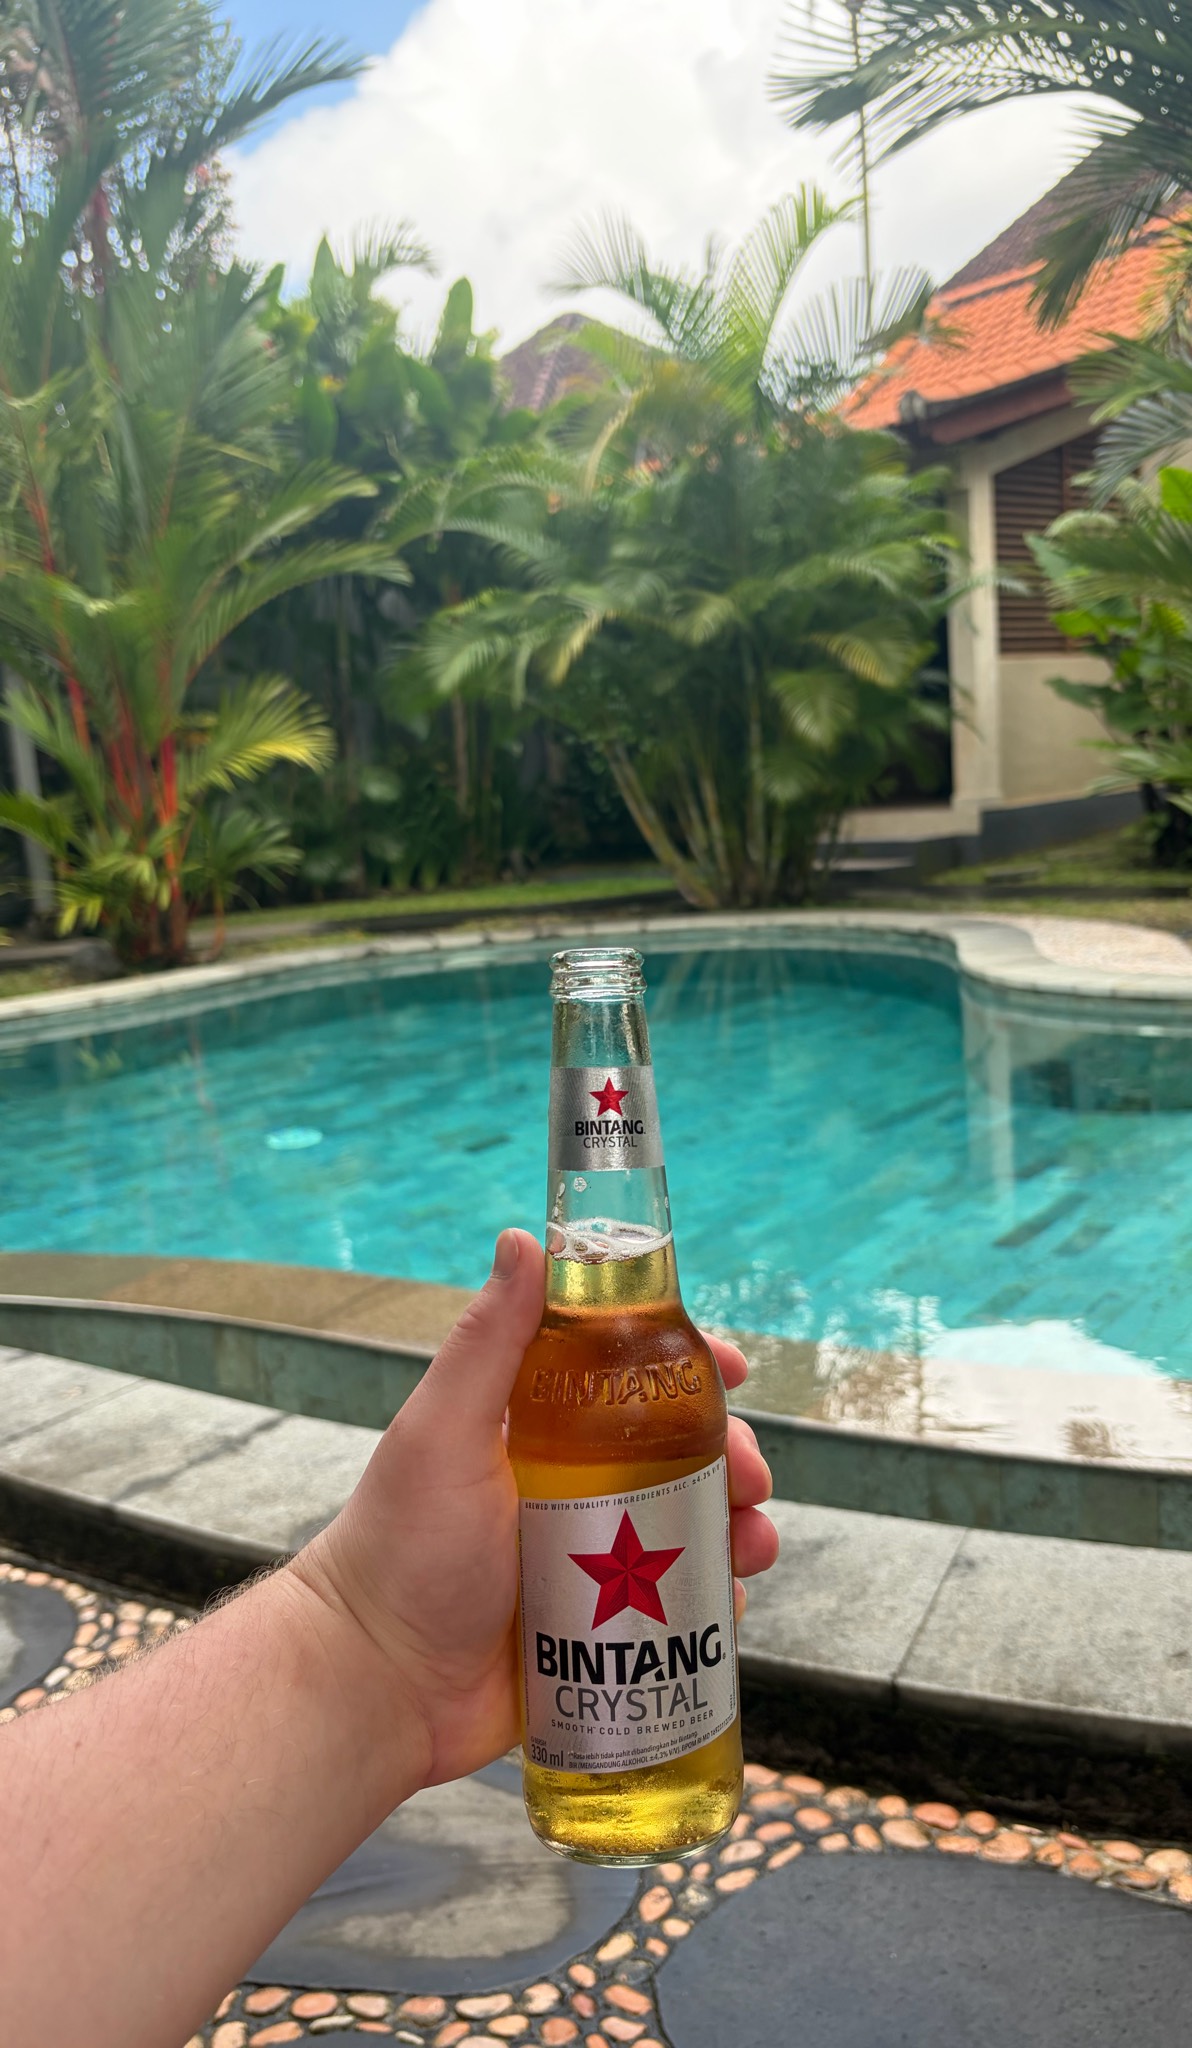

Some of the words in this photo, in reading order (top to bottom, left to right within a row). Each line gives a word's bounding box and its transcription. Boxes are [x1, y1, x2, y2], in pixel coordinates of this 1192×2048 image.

[583, 1136, 638, 1149] CRYSTAL
[530, 1356, 701, 1405] BINTANG
[551, 1503, 570, 1511] WITH
[573, 1499, 610, 1510] QUALITY
[613, 1486, 670, 1506] INGREDIENTS
[673, 1481, 690, 1493] ALC.
[555, 1678, 708, 1722] CRYSTAL
[599, 1726, 631, 1736] COLD
[636, 1719, 686, 1735] BREWED
[690, 1709, 714, 1725] BEER
[531, 1743, 548, 1764] 330
[549, 1750, 564, 1767] ml
